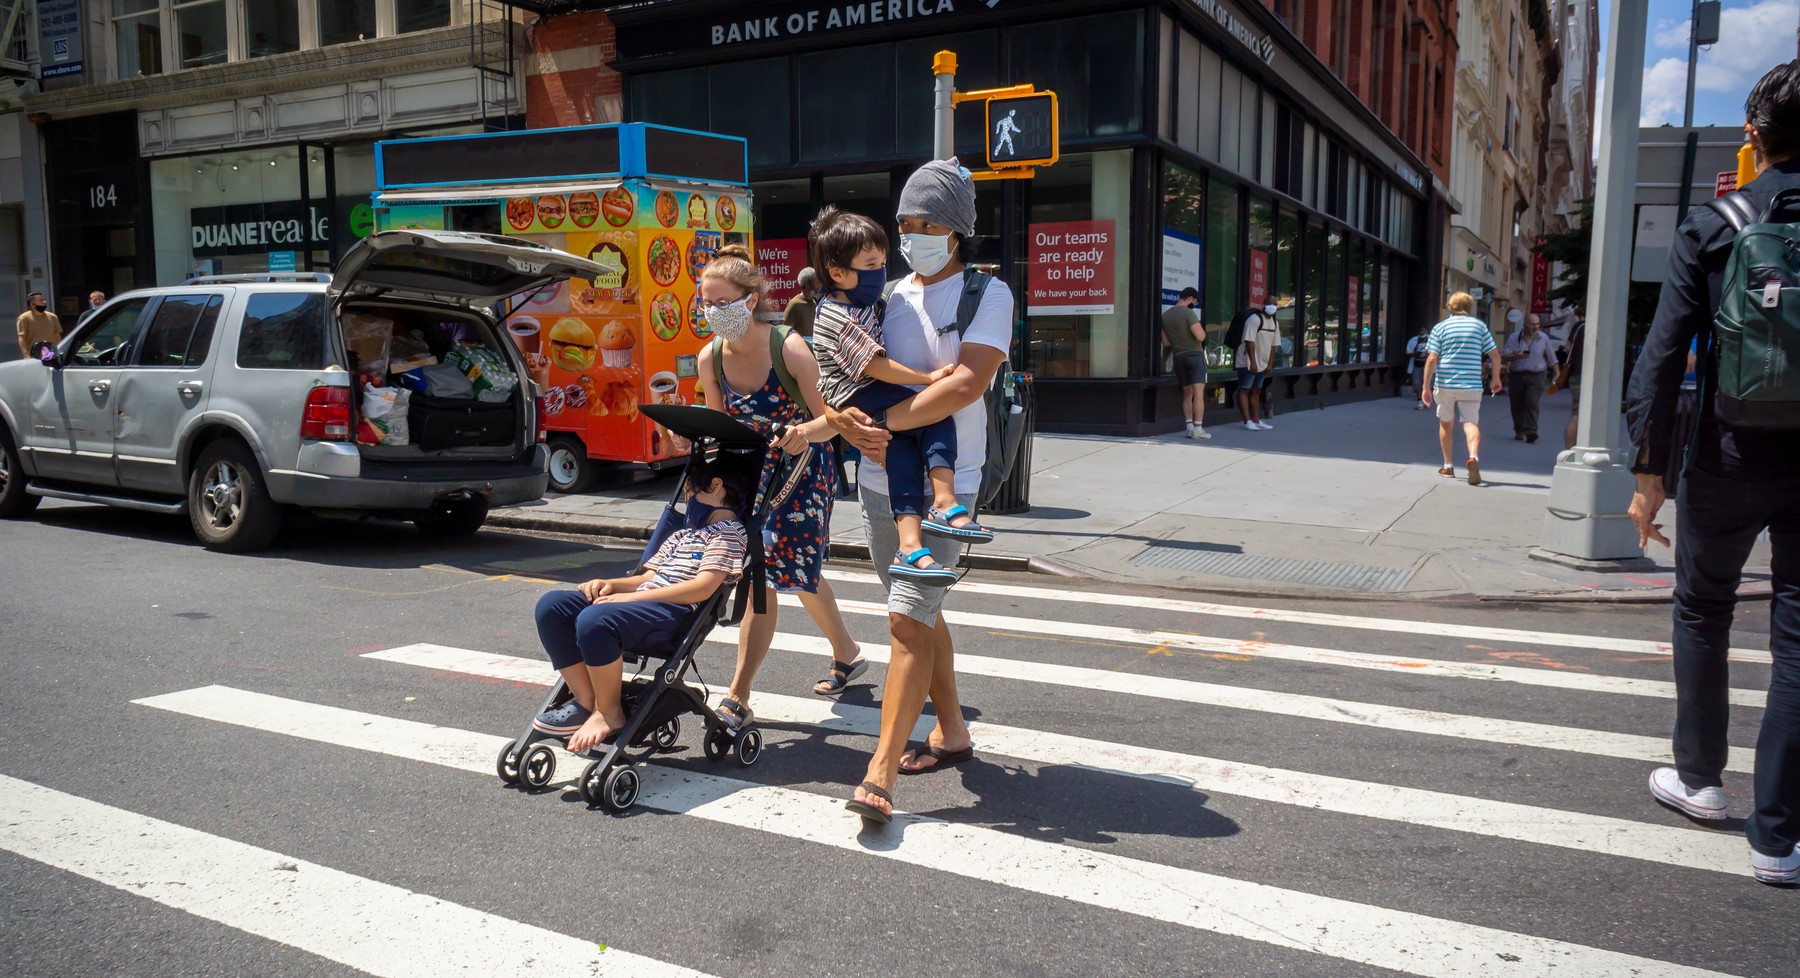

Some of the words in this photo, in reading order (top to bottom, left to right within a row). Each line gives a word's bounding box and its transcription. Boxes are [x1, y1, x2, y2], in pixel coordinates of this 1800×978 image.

[712, 17, 779, 46] BANK
[786, 10, 820, 35] OF
[825, 0, 955, 30] AMERICA
[1216, 4, 1228, 27] OF
[1227, 15, 1261, 58] AMERICA
[91, 184, 117, 208] 184
[1035, 232, 1061, 246] Our
[1065, 232, 1108, 245] teams
[758, 248, 788, 260] We're
[1039, 252, 1061, 263] are
[1065, 247, 1104, 264] ready
[757, 263, 767, 275] in
[770, 262, 790, 275] this
[1047, 268, 1061, 280] to
[1065, 265, 1095, 282] help
[596, 277, 620, 285] FOOD
[587, 289, 604, 298] NEW
[606, 289, 632, 298] YORK
[1034, 289, 1047, 297] We
[1048, 289, 1067, 297] have
[1069, 290, 1087, 299] your
[1088, 288, 1107, 296] back
[775, 480, 794, 503] crocs
